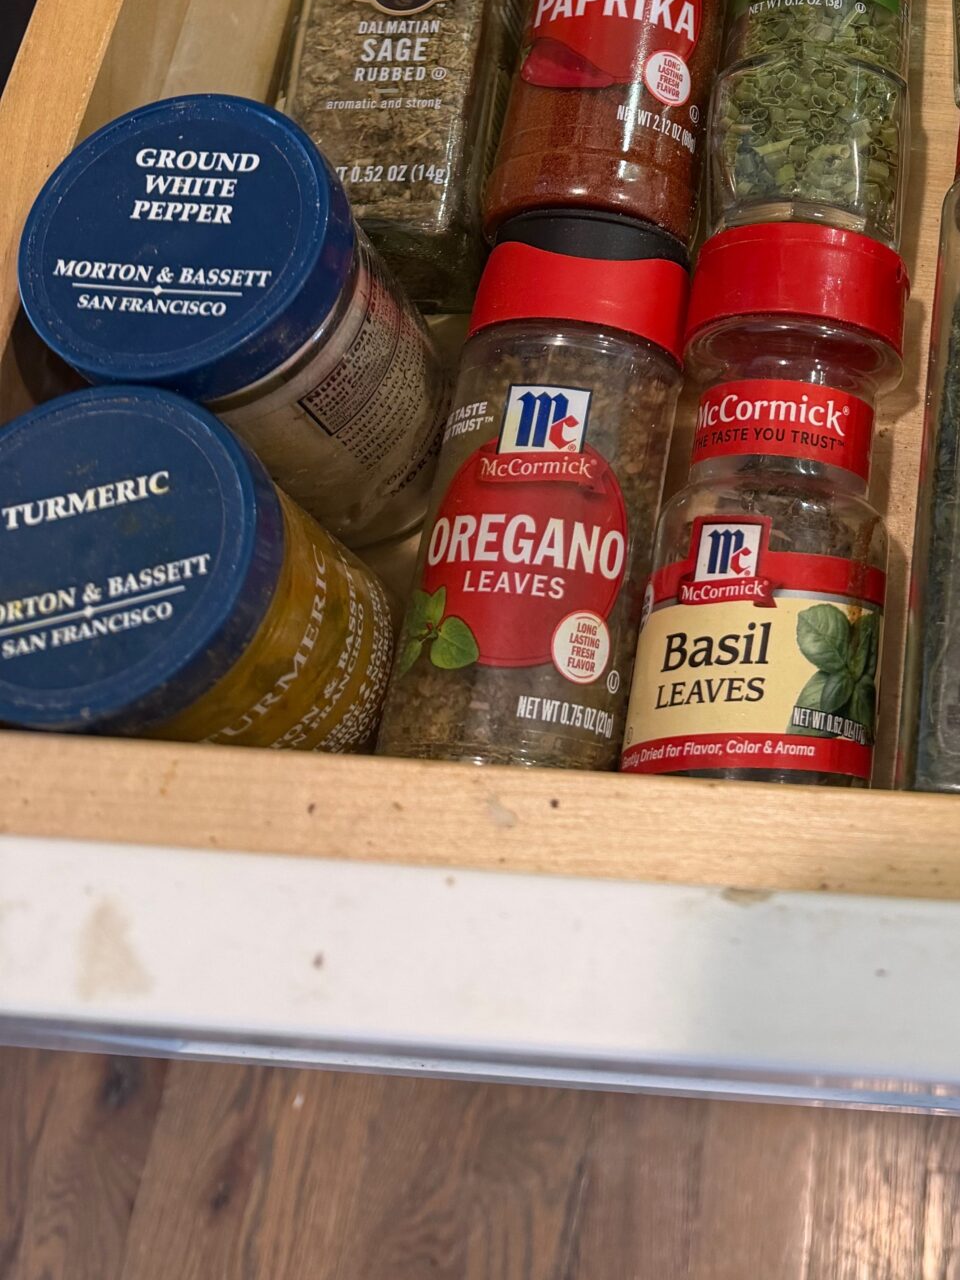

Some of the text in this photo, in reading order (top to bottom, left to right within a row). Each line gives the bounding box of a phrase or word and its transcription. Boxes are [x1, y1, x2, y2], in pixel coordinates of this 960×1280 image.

[749, 0, 765, 15] NET
[358, 20, 440, 35] DALMATIAN
[360, 37, 430, 62] SAGE
[354, 66, 426, 82] RUBBED
[658, 64, 684, 82] LASTING
[664, 58, 681, 71] LONG
[656, 82, 681, 98] FLAVOR
[660, 74, 680, 89] FRESH
[326, 97, 442, 111] aromatic and strong
[638, 109, 683, 141] WT 2.12 OZ
[135, 148, 260, 172] GROUND
[350, 163, 451, 184] 0.52 OZ (14g)
[144, 174, 238, 198] WHITE
[130, 199, 233, 224] PEPPER
[53, 259, 272, 287] MORTON & BASSETT
[77, 294, 227, 317] SAN FRANCISCO
[455, 401, 488, 421] TASTE
[698, 394, 846, 437] McCormick
[711, 427, 748, 443] TASTE
[754, 427, 785, 442] YOU
[480, 456, 593, 479] McCormick
[2, 471, 170, 530] TURMERIC
[427, 514, 624, 581] OREGANO
[82, 582, 102, 604] &
[108, 554, 211, 598] BASSETT
[462, 570, 567, 600] LEAVES
[681, 580, 766, 602] McCormick
[2, 602, 173, 659] SAN FRANCISCO
[569, 632, 600, 649] LASTING
[577, 622, 597, 636] LONG
[571, 645, 595, 660] FRESH
[661, 621, 773, 673] Basil
[567, 657, 596, 673] FLAVOR
[655, 677, 766, 711] LEAVES
[516, 695, 541, 720] NET
[541, 698, 560, 723] WT
[560, 702, 584, 727] 0.75
[584, 707, 597, 731] OZ
[792, 706, 843, 735] NET WT 0.62
[640, 740, 815, 762] Dried for Flavor, Color & Aroma
